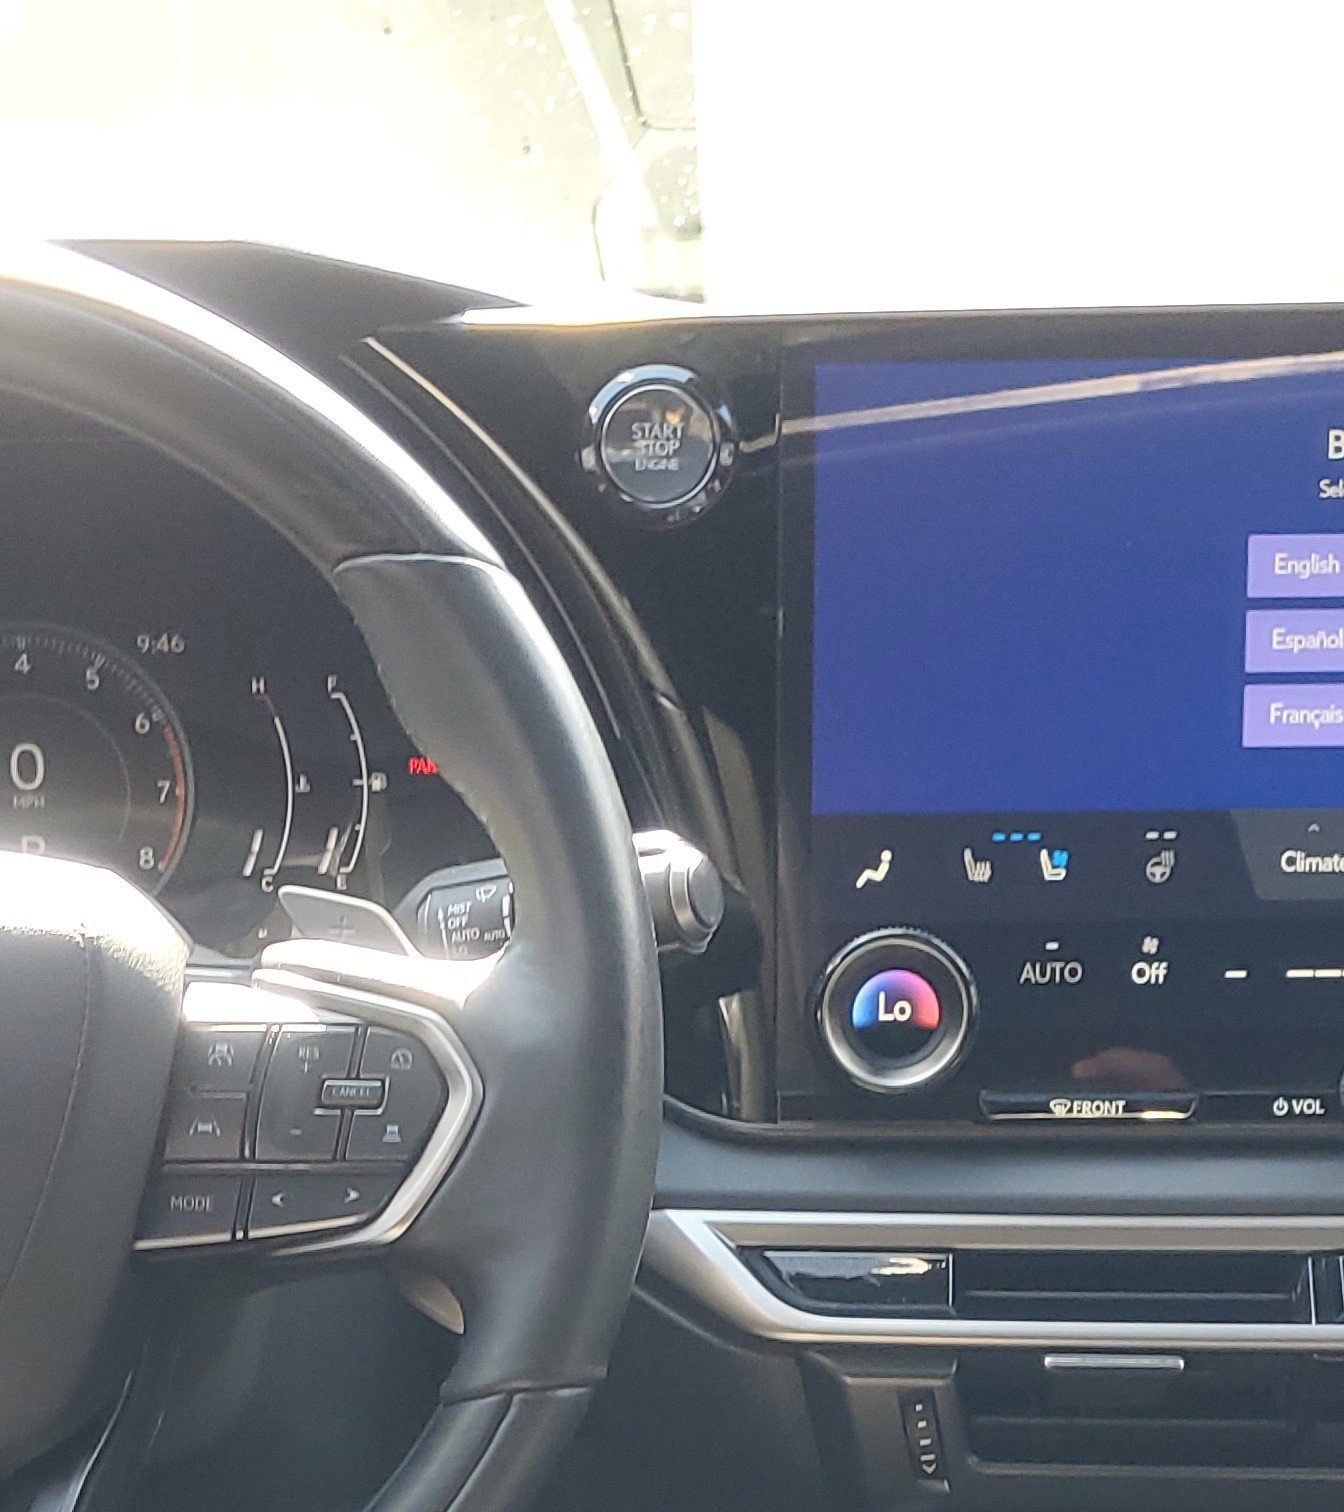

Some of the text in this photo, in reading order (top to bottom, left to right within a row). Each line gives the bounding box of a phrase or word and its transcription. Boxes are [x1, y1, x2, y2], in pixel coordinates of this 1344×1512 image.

[632, 422, 684, 440] START
[635, 440, 681, 456] STOP
[1274, 553, 1340, 578] English
[136, 633, 185, 653] 9:46
[1272, 627, 1344, 653] Español
[14, 653, 31, 675] 4
[85, 667, 100, 690] 5
[251, 677, 265, 694] H
[135, 712, 150, 734] 6
[1269, 702, 1344, 729] Français
[10, 743, 45, 790] 0
[157, 780, 170, 803] 7
[139, 846, 155, 869] 8
[261, 876, 274, 893] C
[447, 901, 472, 916] MIST
[447, 914, 469, 930] OFF
[451, 927, 480, 945] AUTO
[1020, 962, 1083, 985] AUTO
[1131, 961, 1168, 985] Off
[877, 991, 912, 1022] Lo
[1072, 1099, 1325, 1116] FRONT VOL
[170, 1195, 214, 1212] MODE
